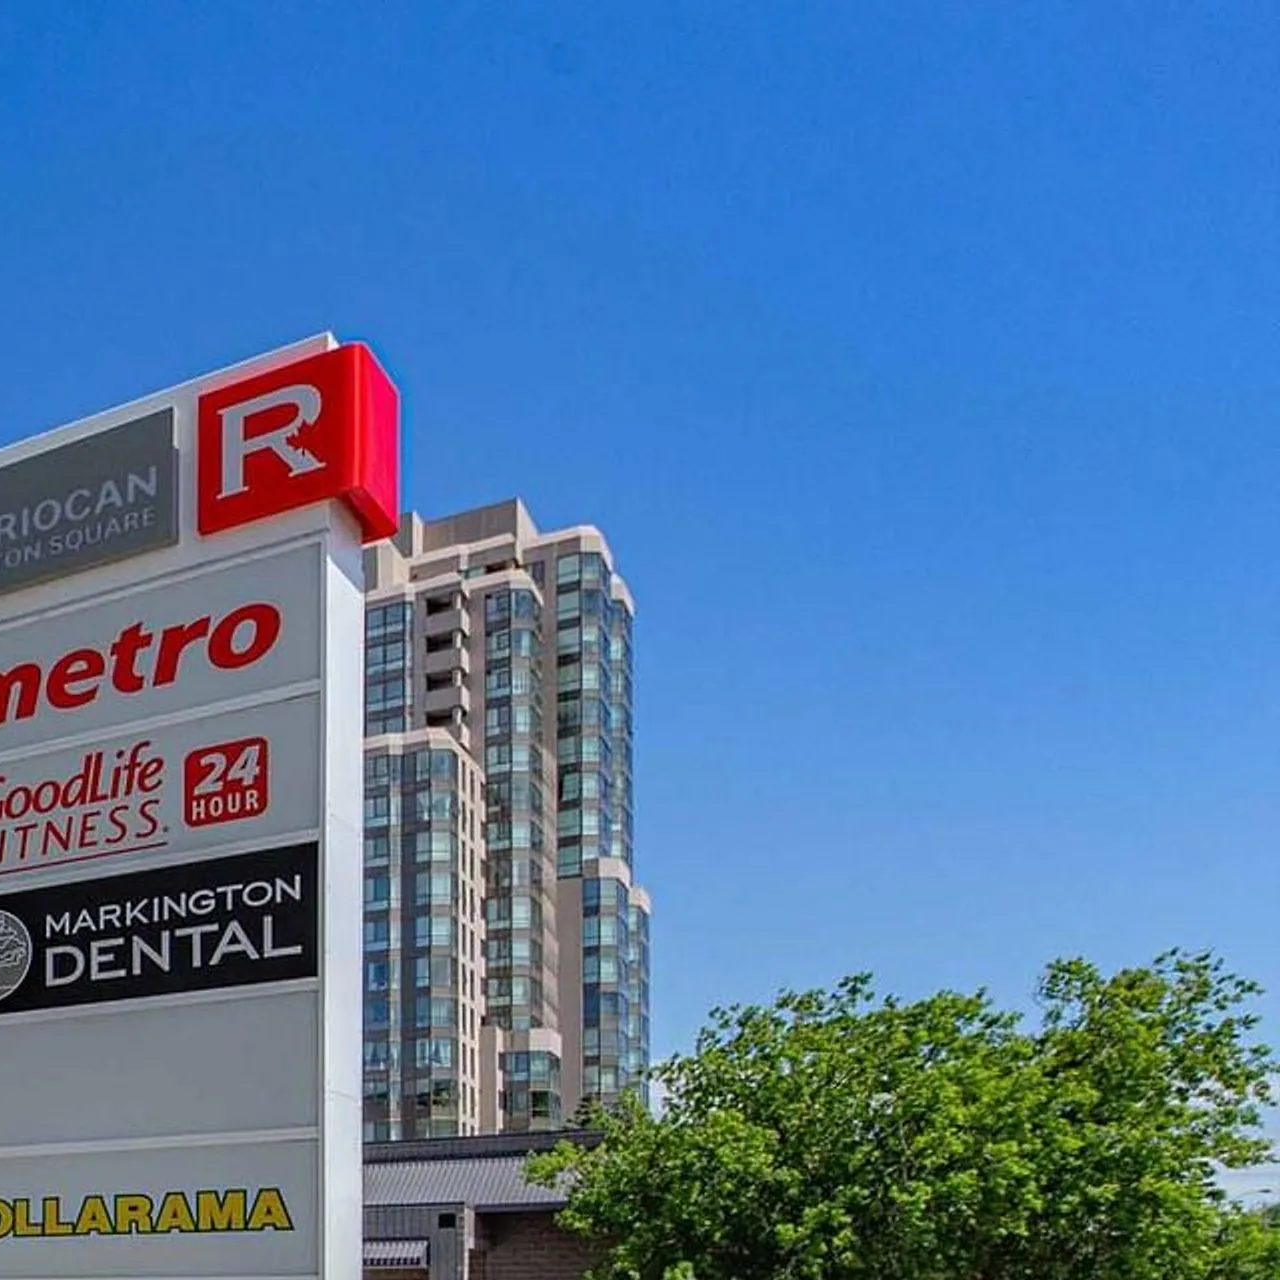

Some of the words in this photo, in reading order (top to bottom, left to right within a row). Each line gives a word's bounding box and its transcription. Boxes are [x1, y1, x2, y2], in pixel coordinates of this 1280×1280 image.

[215, 383, 327, 500] R
[48, 506, 156, 555] SQUARE
[193, 744, 262, 797] 24
[191, 789, 260, 822] HOUR
[44, 873, 303, 940] MARKINGTON
[44, 914, 303, 989] DENTAL
